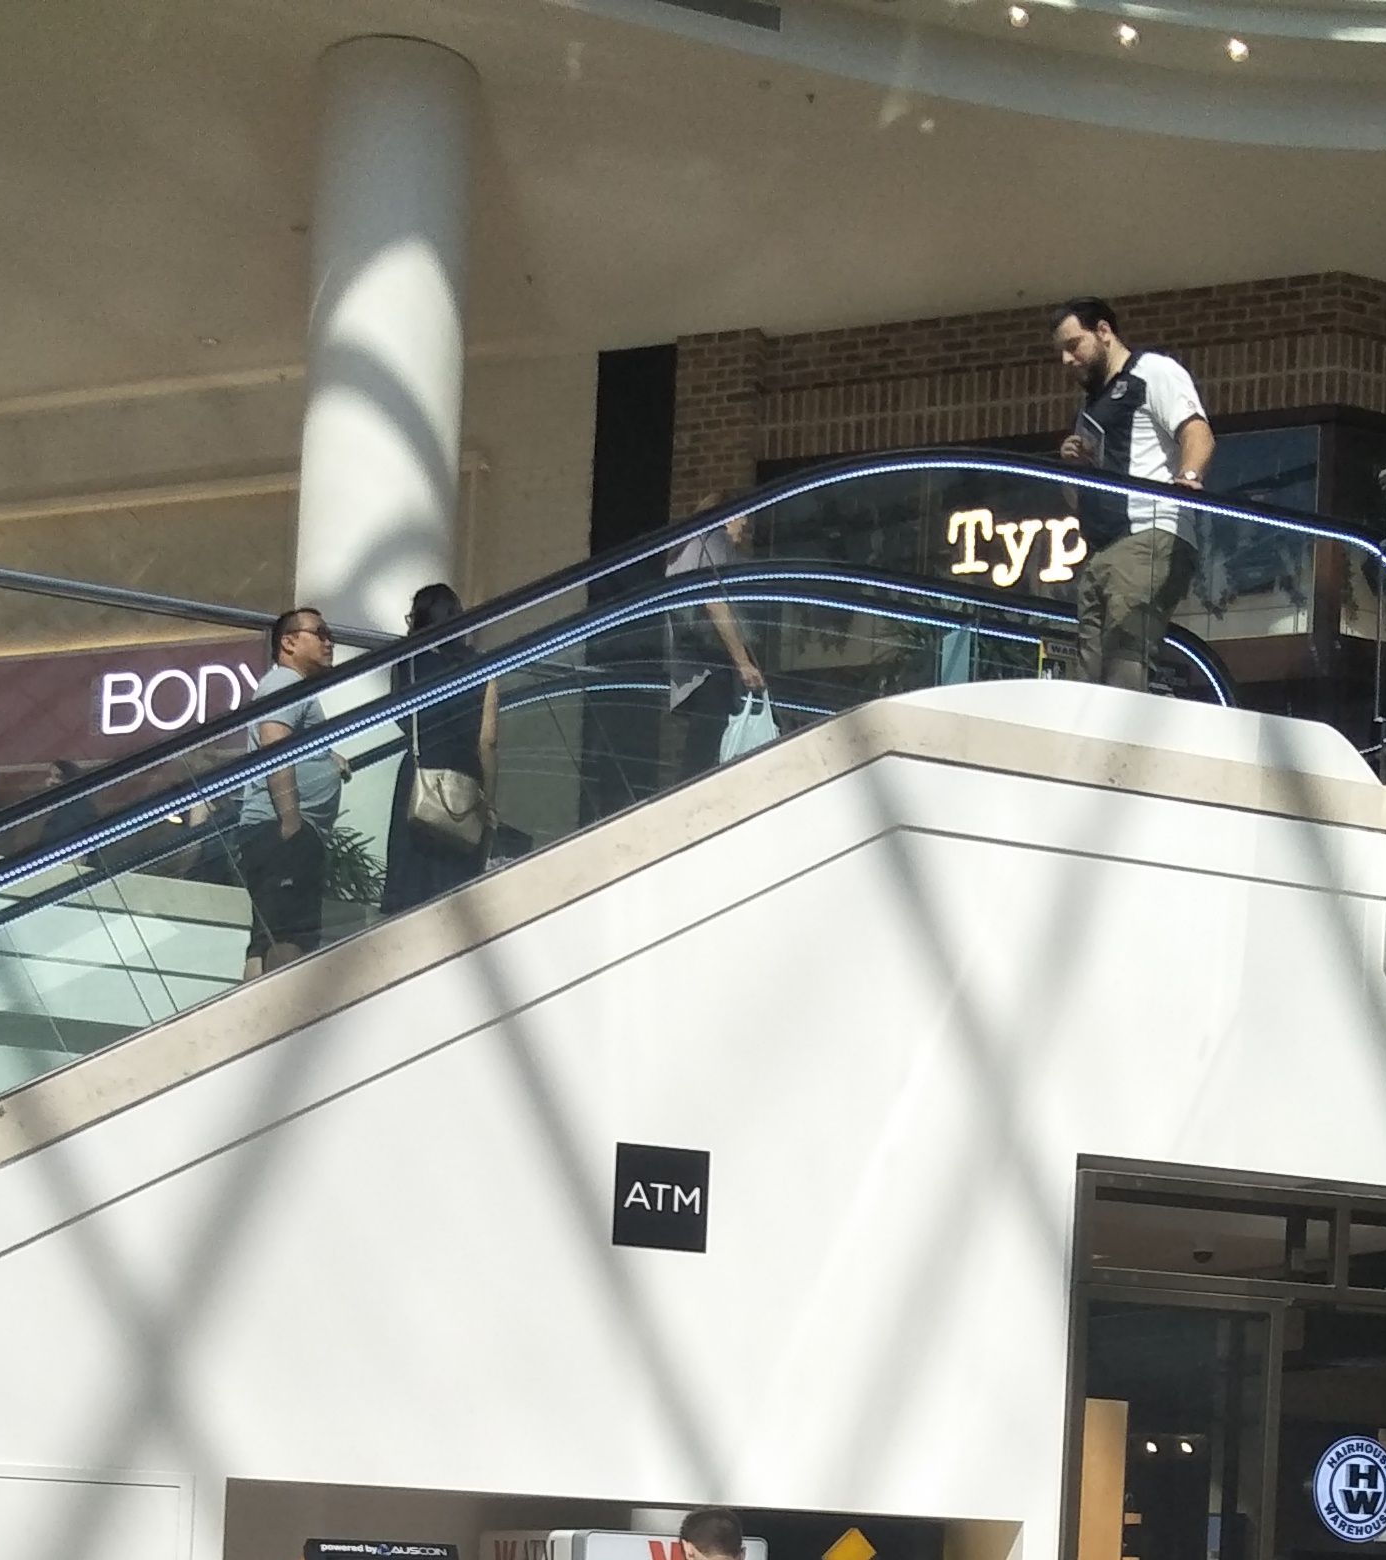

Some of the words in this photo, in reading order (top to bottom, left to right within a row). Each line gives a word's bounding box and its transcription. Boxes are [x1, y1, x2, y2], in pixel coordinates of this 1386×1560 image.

[102, 662, 259, 735] BOD
[623, 1181, 701, 1215] ATM
[319, 1543, 364, 1553] powered
[365, 1545, 378, 1555] by
